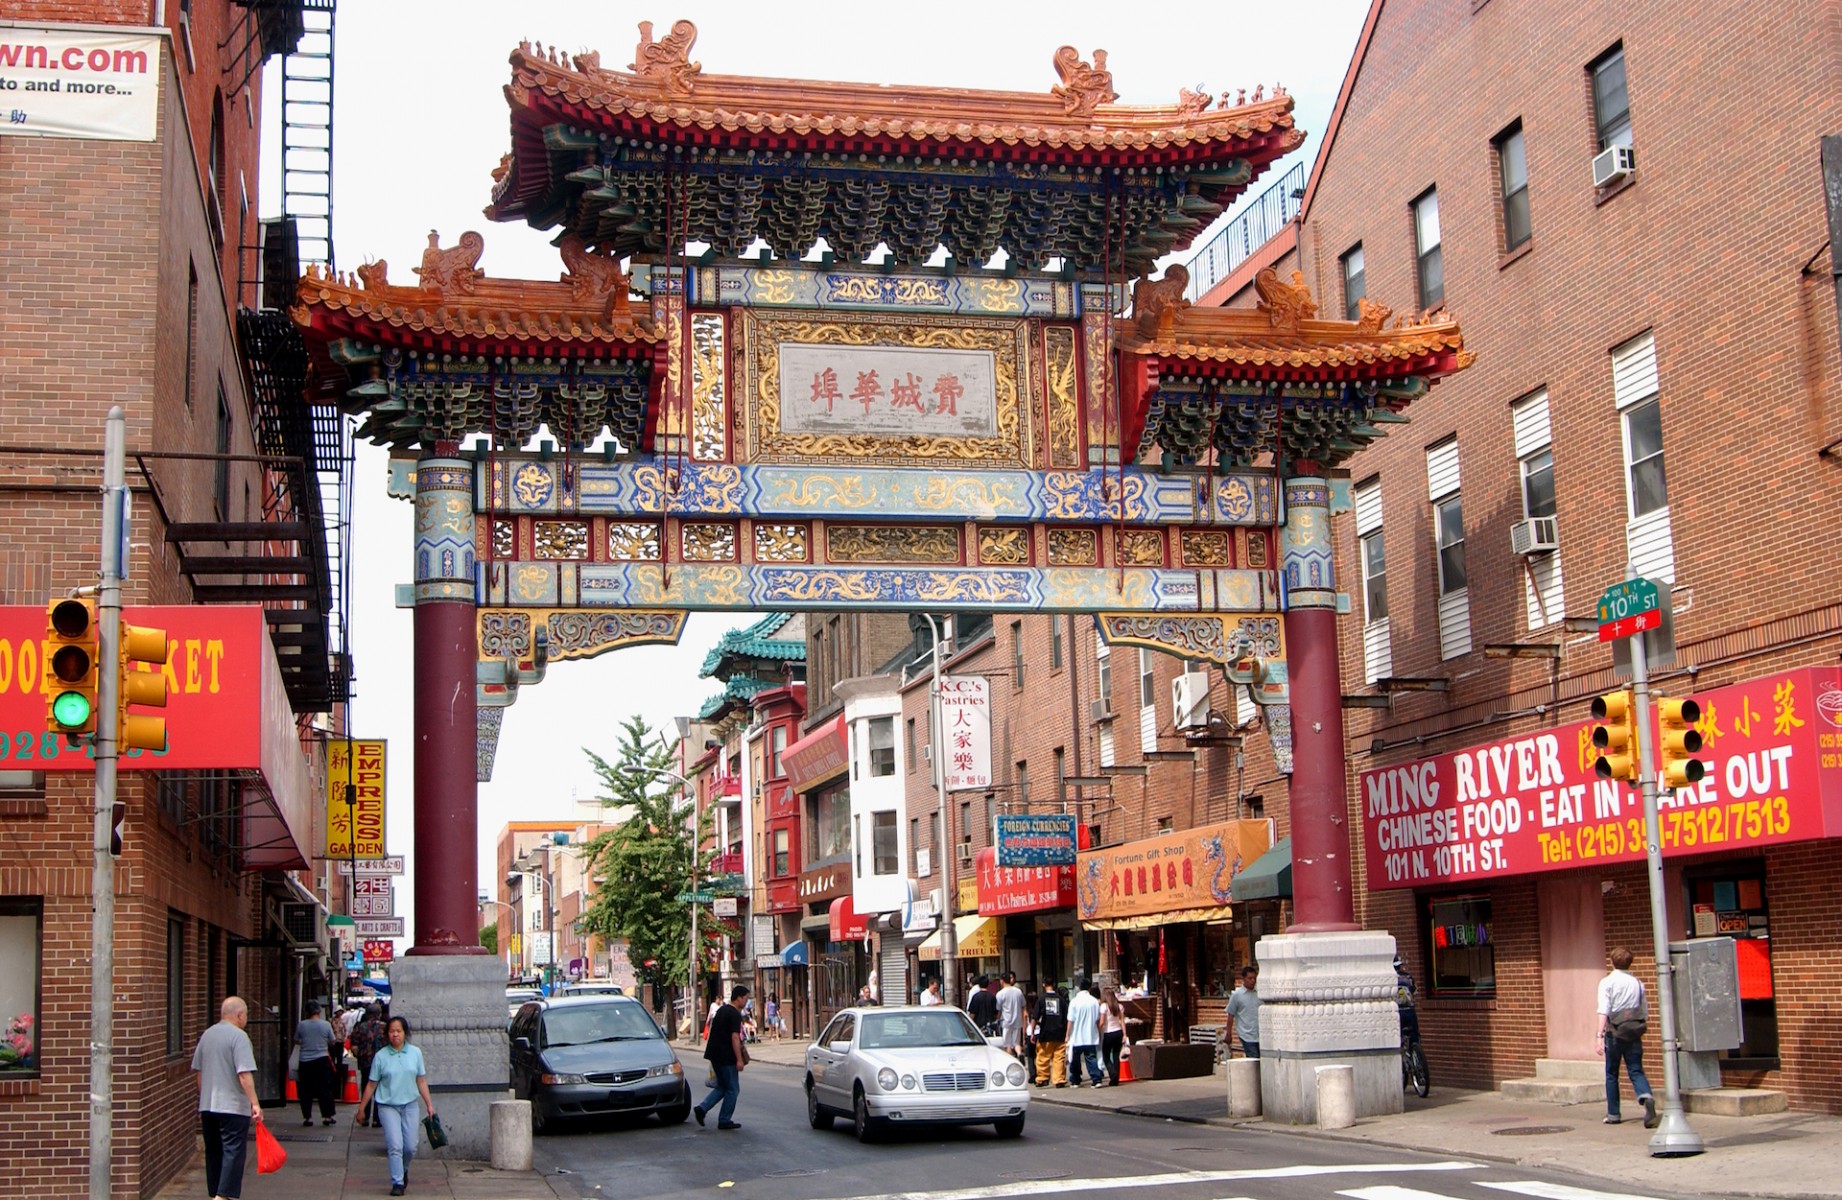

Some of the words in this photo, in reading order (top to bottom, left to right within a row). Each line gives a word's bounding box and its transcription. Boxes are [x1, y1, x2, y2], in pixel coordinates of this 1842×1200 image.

[25, 79, 60, 92] and
[66, 82, 132, 96] more...
[1623, 585, 1629, 596] N
[1610, 592, 1639, 619] 10TH
[1643, 593, 1657, 610] ST
[952, 708, 974, 771] 大家樂
[1366, 760, 1440, 819] MING
[1453, 734, 1565, 802] RIVER
[357, 744, 382, 840] EMPRESS
[1377, 807, 1459, 852] CHINESE
[1463, 797, 1522, 839] FOOD
[1539, 784, 1587, 828] EAT
[1593, 778, 1621, 819] IN
[1725, 745, 1793, 799] OUT
[1003, 820, 1030, 833] FOREIGN
[330, 842, 383, 854] GARDEN
[1538, 830, 1573, 864] Tel:
[1576, 821, 1625, 859] (215)
[1114, 853, 1143, 865] Fortune
[1146, 848, 1160, 859] Gift
[1164, 845, 1184, 857] Shop
[1384, 851, 1410, 882] 101
[1412, 850, 1430, 879] N.
[1433, 842, 1475, 876] 10TH
[1480, 838, 1508, 871] ST.
[361, 922, 374, 932] ARTS
[380, 922, 398, 932] CRAFTS
[1719, 918, 1746, 932] OPEN
